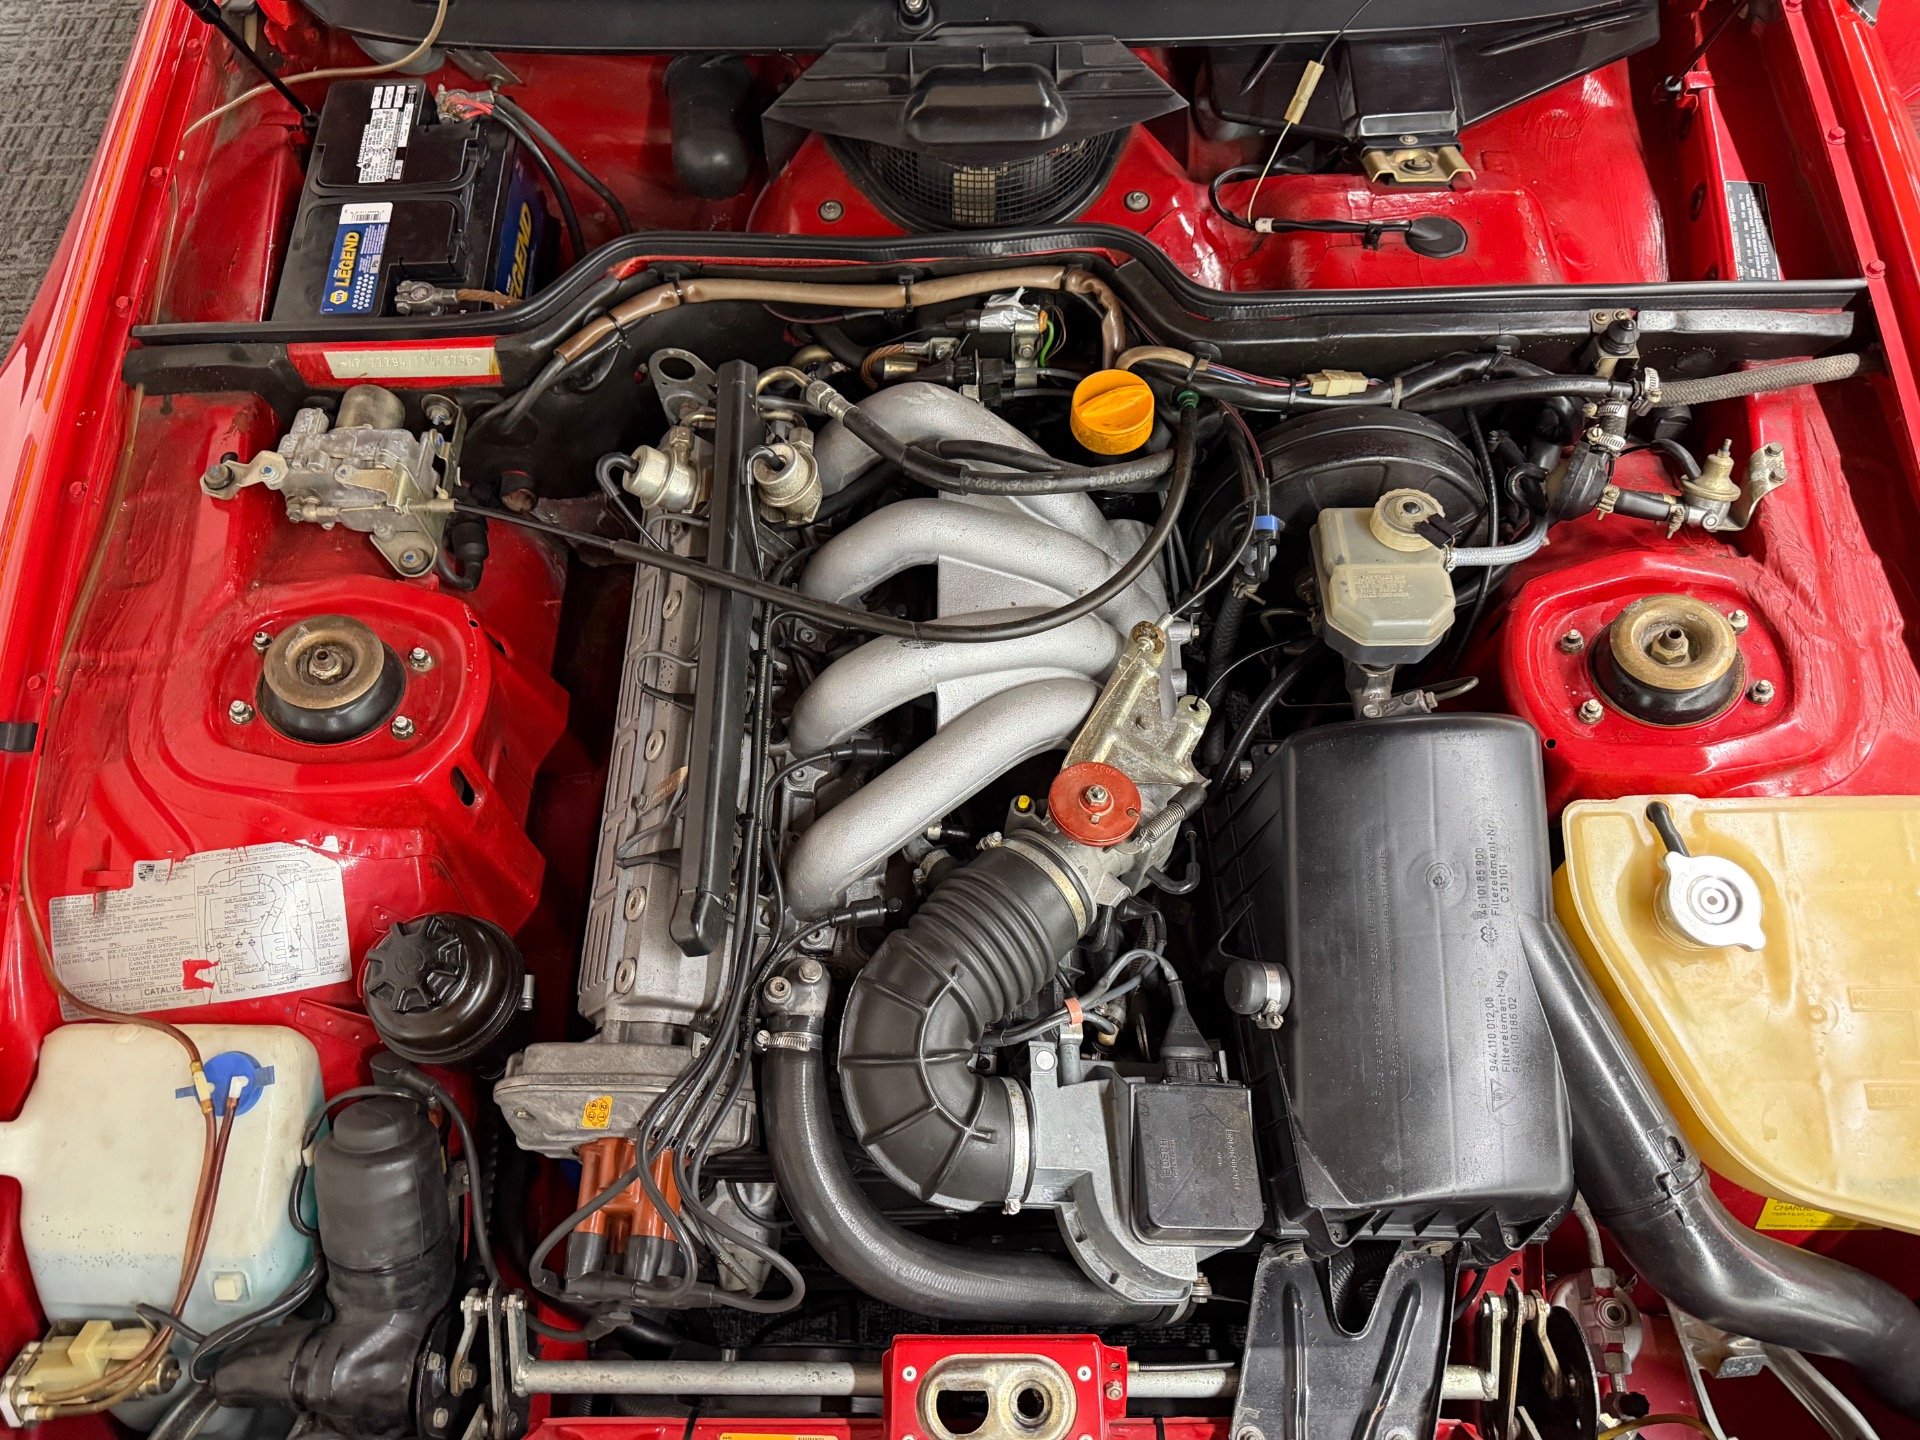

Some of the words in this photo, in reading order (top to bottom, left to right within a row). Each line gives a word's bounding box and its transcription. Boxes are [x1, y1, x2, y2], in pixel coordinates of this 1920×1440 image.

[335, 232, 360, 287] LEGEND
[1474, 847, 1485, 866] 900
[1379, 849, 1389, 898] intervals
[1475, 869, 1486, 882] 85
[1498, 864, 1509, 879] 101
[1476, 885, 1487, 900] 101
[1499, 882, 1509, 892] 31
[1382, 903, 1391, 954] specified
[1160, 1139, 1171, 1176] BOSCH
